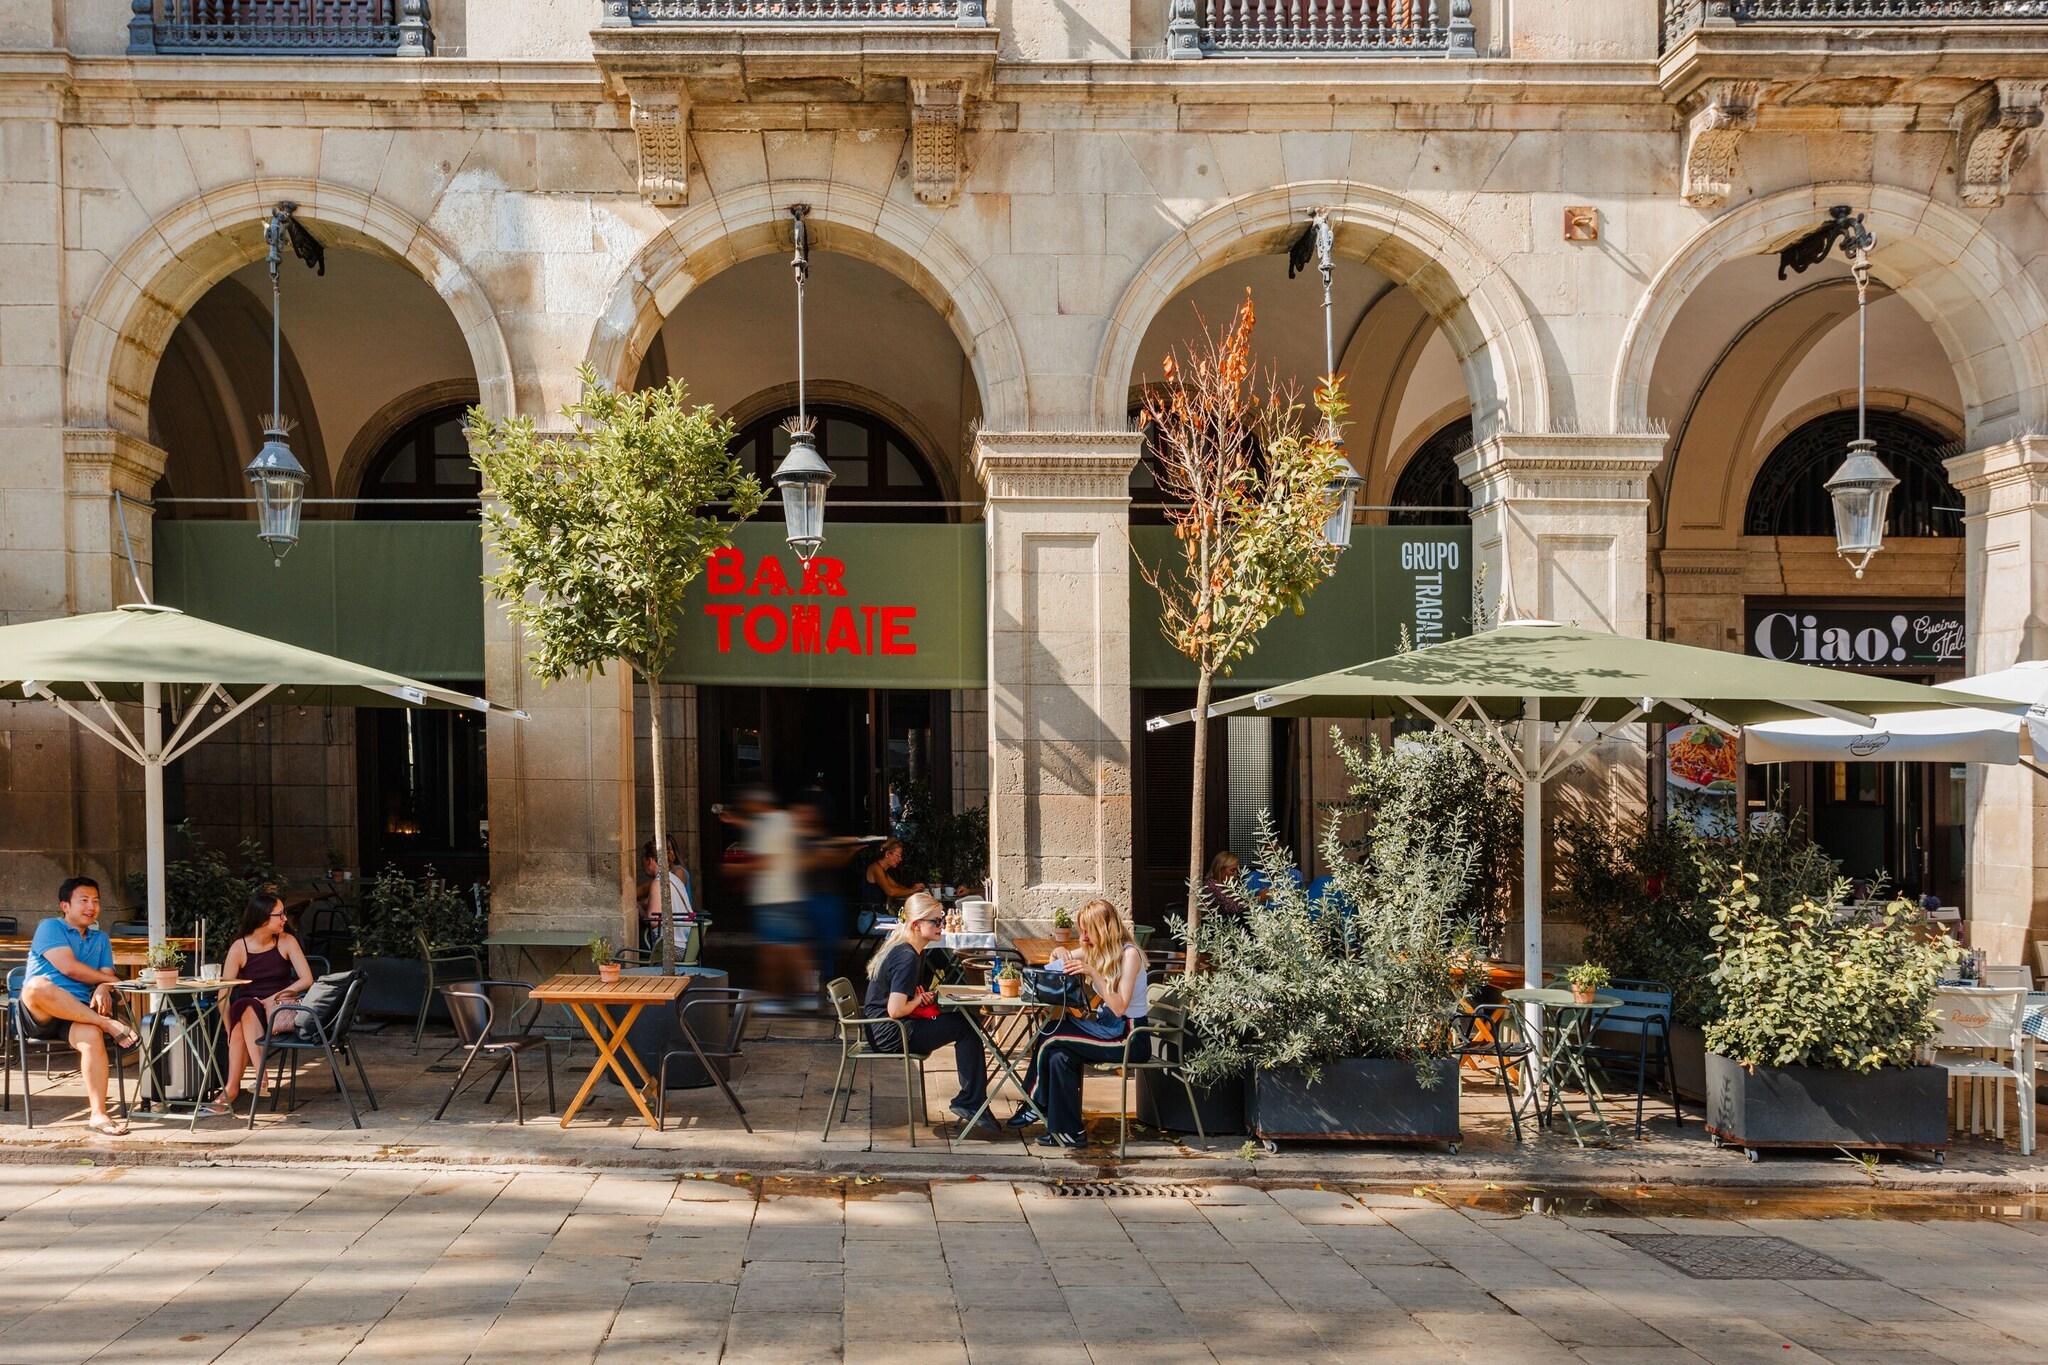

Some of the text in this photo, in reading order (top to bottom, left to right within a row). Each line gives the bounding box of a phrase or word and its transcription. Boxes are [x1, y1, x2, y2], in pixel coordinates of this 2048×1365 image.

[706, 546, 849, 597] BAR
[1401, 541, 1460, 571] GRUPO
[704, 604, 918, 656] TOMATE
[1754, 612, 1909, 662] Ciao!
[1913, 615, 1959, 644] Cucina
